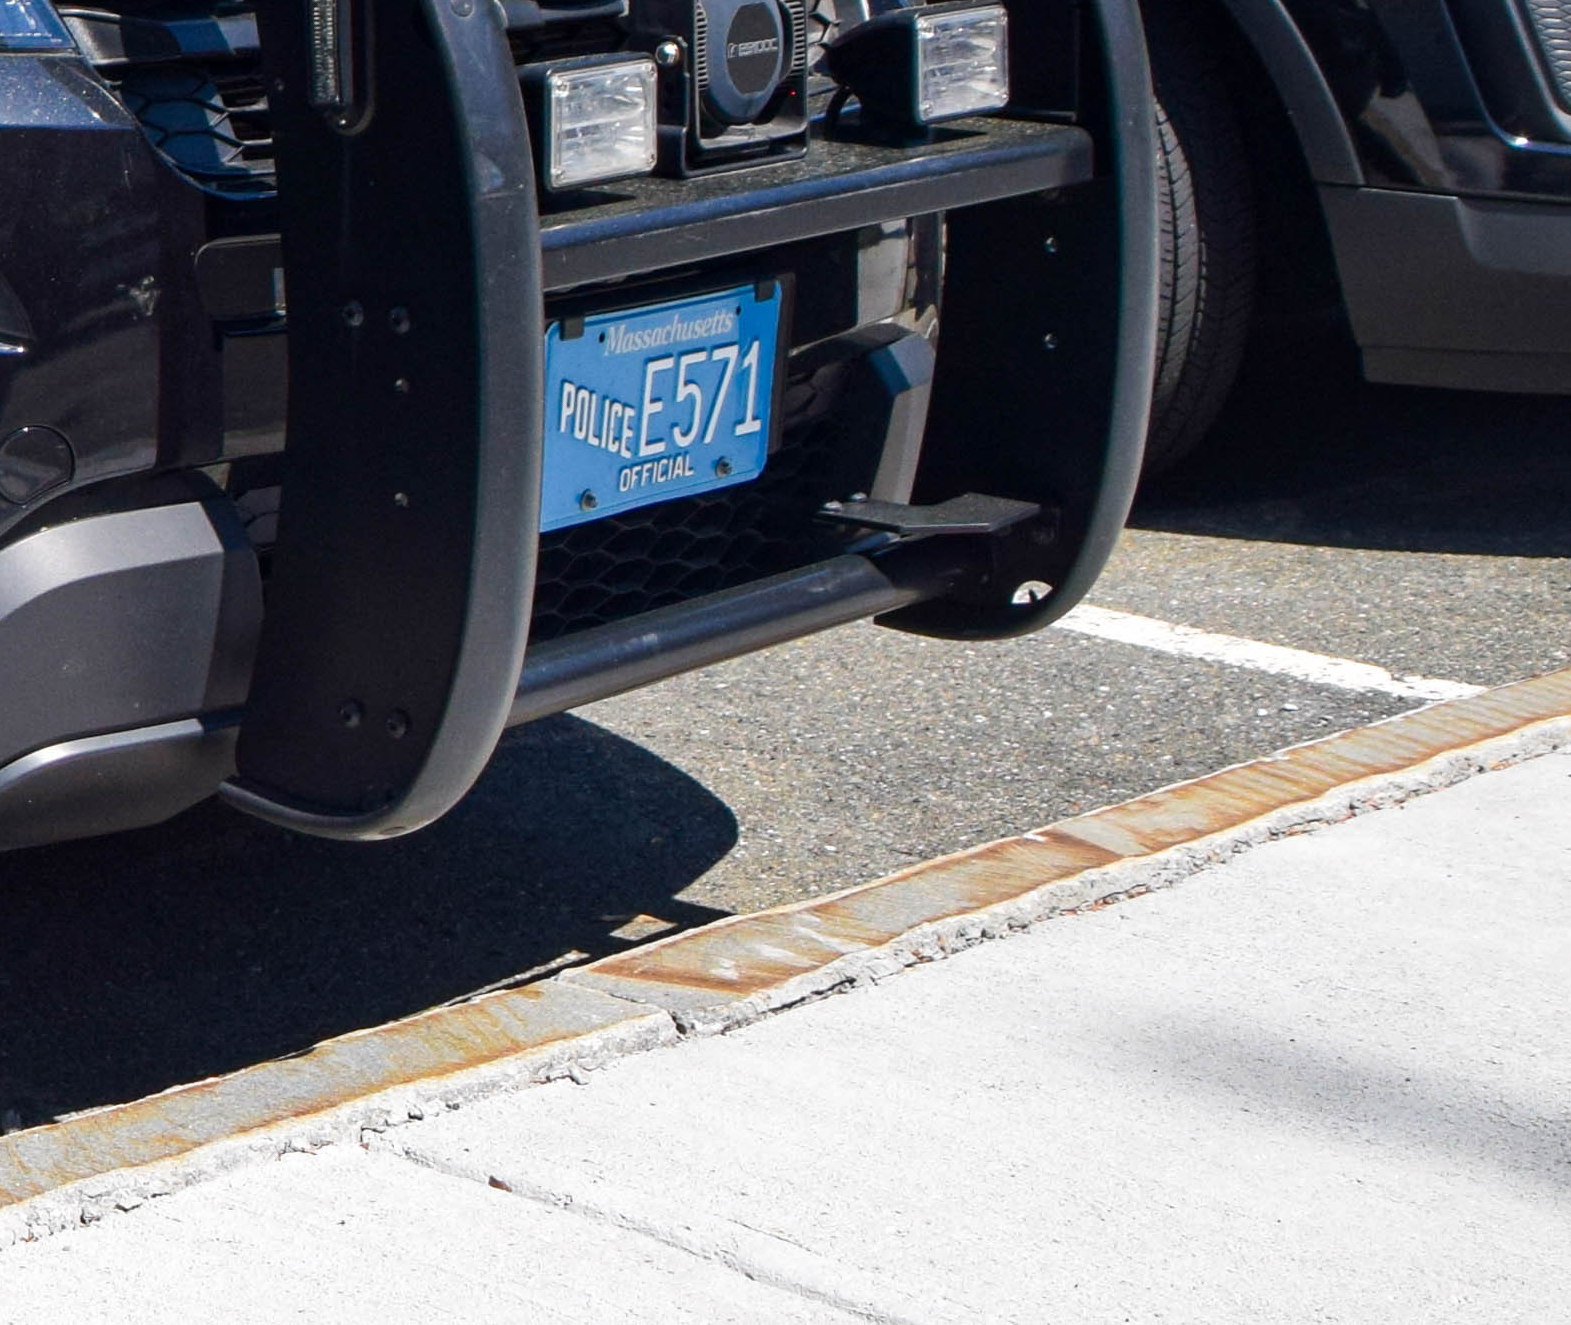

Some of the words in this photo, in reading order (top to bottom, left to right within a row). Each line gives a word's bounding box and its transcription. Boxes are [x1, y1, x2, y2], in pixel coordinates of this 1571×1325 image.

[603, 307, 735, 357] Massachusetts
[560, 381, 635, 459] POLICE
[639, 340, 762, 458] E571
[619, 455, 695, 492] OFFICIAL
